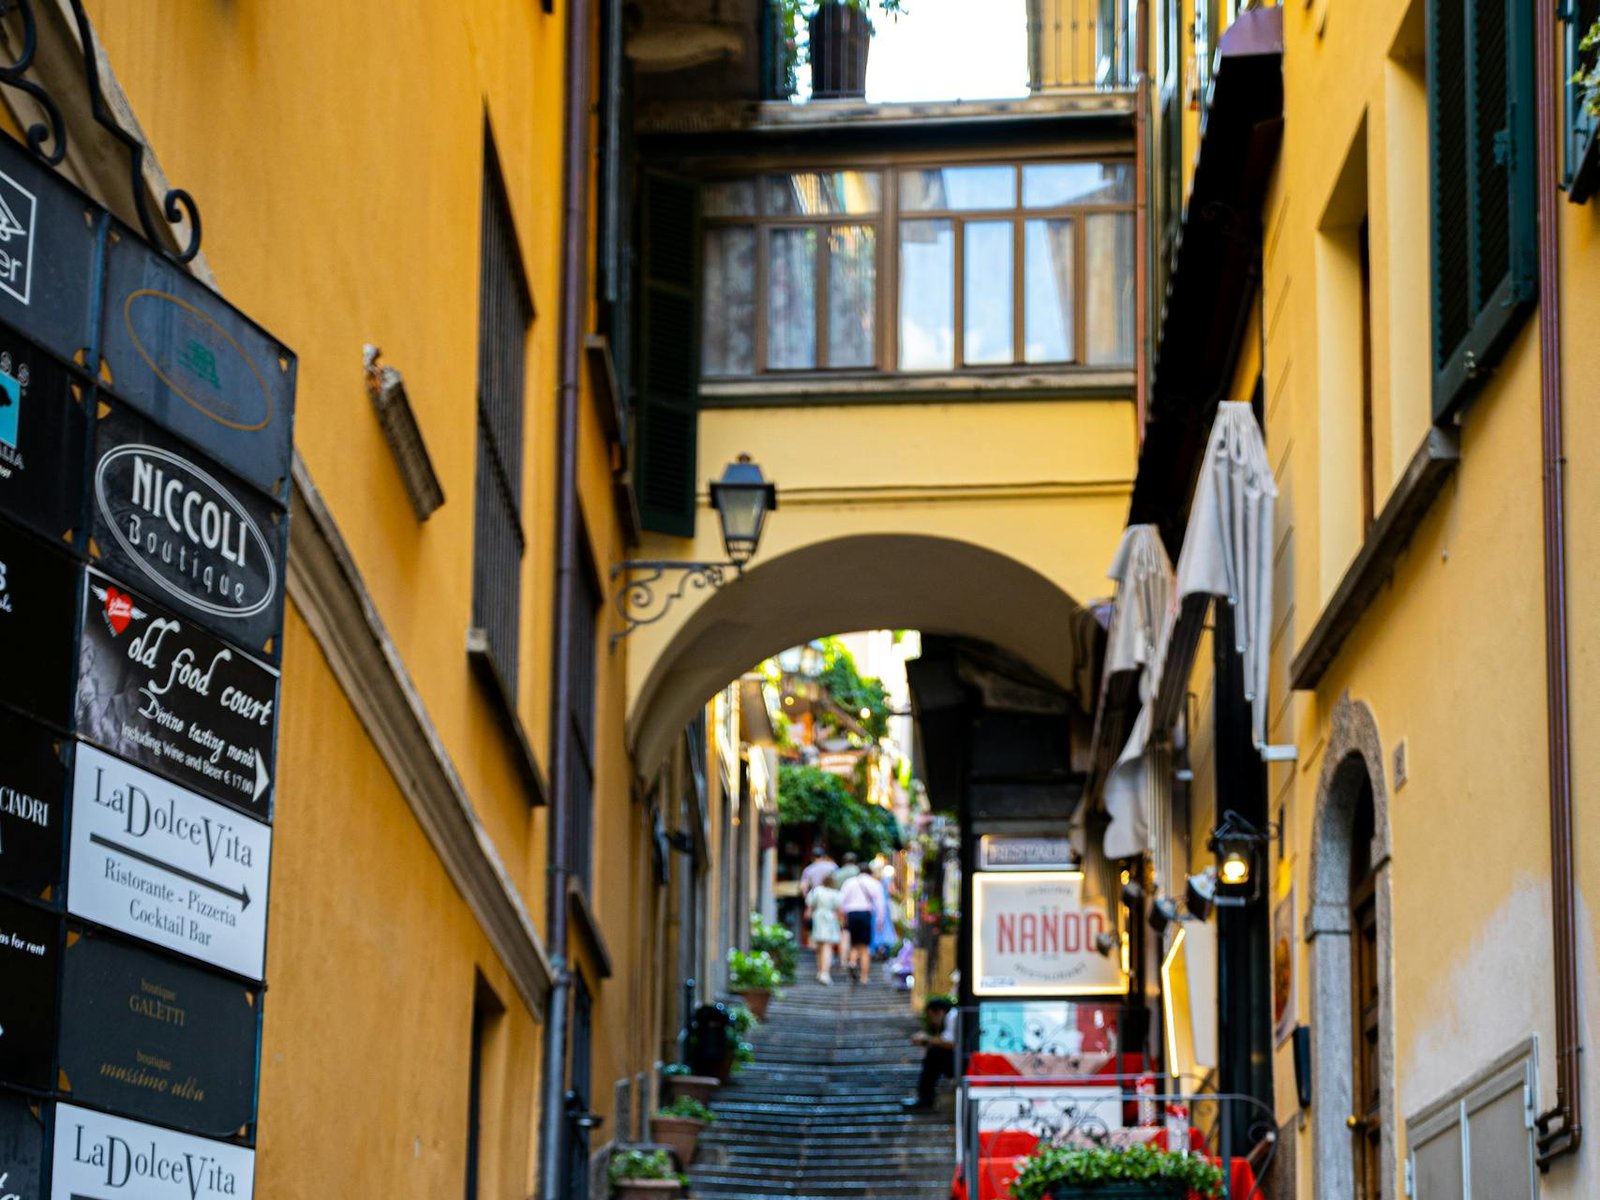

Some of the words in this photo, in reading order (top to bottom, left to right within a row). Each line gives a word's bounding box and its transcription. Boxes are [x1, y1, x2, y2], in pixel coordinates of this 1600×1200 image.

[131, 455, 247, 567] NICCOLI
[129, 513, 245, 604] Boutique
[128, 617, 181, 668] old
[148, 647, 232, 695] food
[138, 687, 184, 733] Divine
[188, 722, 224, 764] tasting
[220, 685, 272, 726] court
[121, 721, 163, 757] Including
[163, 740, 185, 764] Wine
[185, 752, 201, 772] and
[202, 759, 224, 781] Beer
[0, 786, 49, 827] CIADRI
[104, 856, 174, 903] Ristorante
[187, 889, 237, 928] Pizzeria
[11, 932, 25, 950] for
[26, 942, 46, 956] rent
[129, 898, 184, 937] Cocktail
[189, 920, 212, 947] Bar
[100, 1062, 168, 1093] massimo
